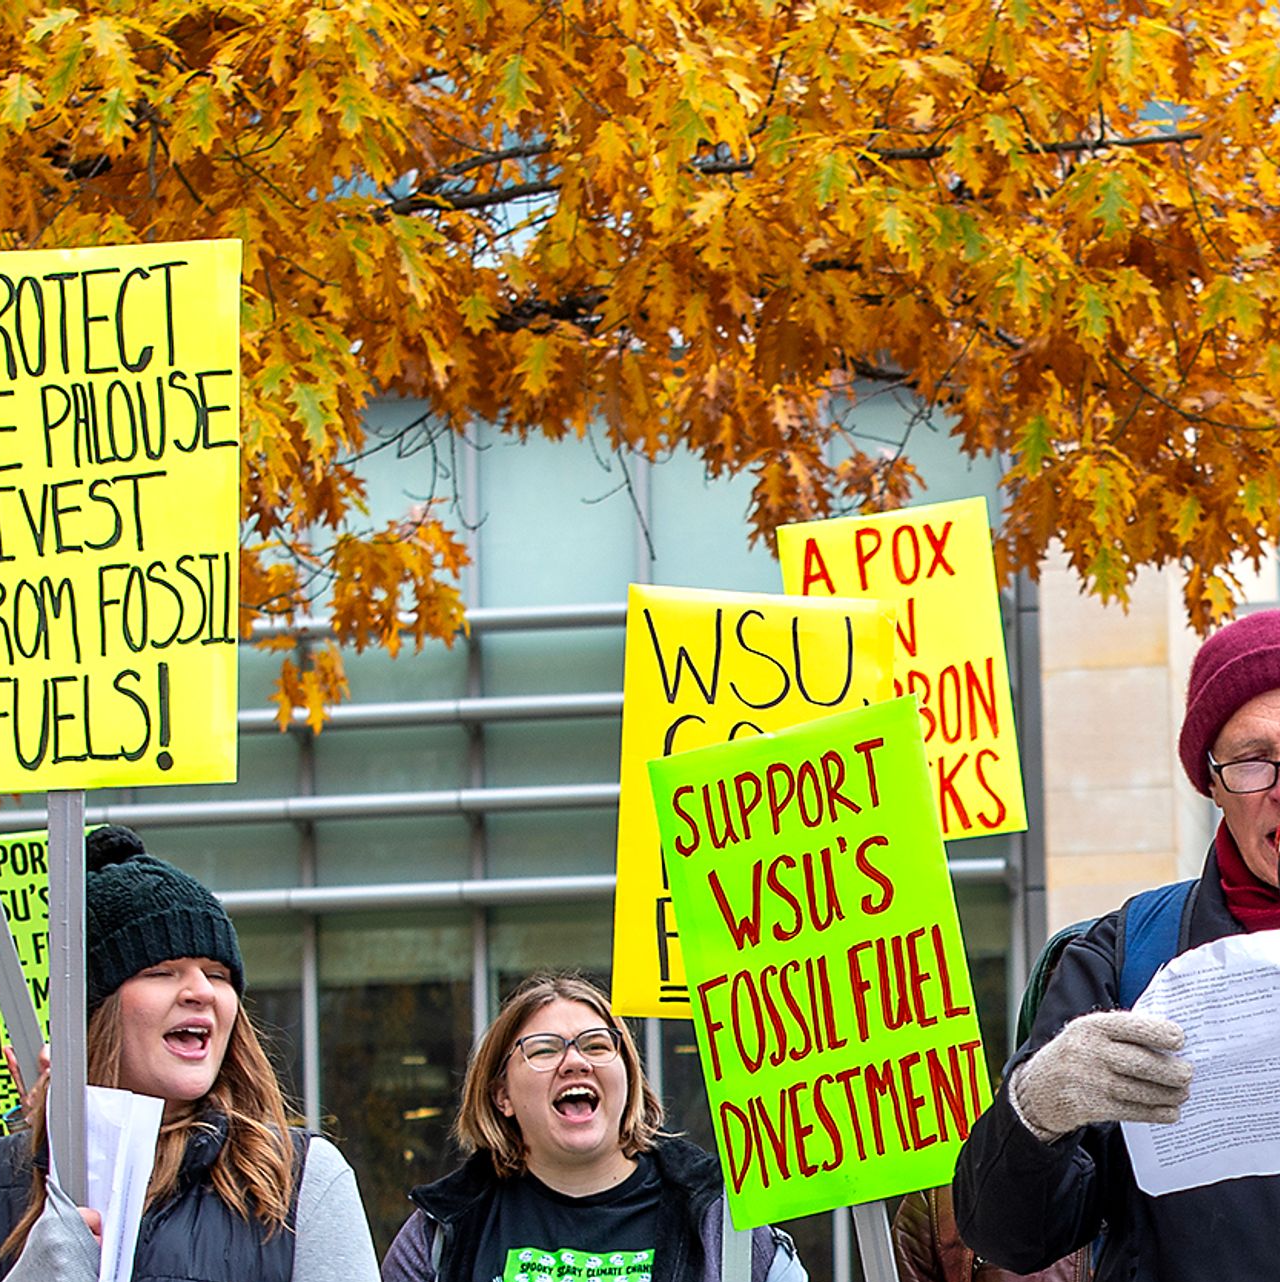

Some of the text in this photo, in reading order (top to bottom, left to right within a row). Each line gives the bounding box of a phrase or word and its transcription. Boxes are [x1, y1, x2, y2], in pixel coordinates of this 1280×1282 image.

[39, 370, 239, 467] PALOUSE
[99, 553, 236, 656] FOSSIL
[801, 521, 955, 596] A POX
[896, 598, 916, 657] N
[894, 658, 999, 744] BON
[671, 737, 886, 858] SUPPORT
[708, 835, 894, 951] WSU'S
[697, 923, 971, 1080] FOSSIL FUEL
[719, 1039, 982, 1195] DIVESTMENT
